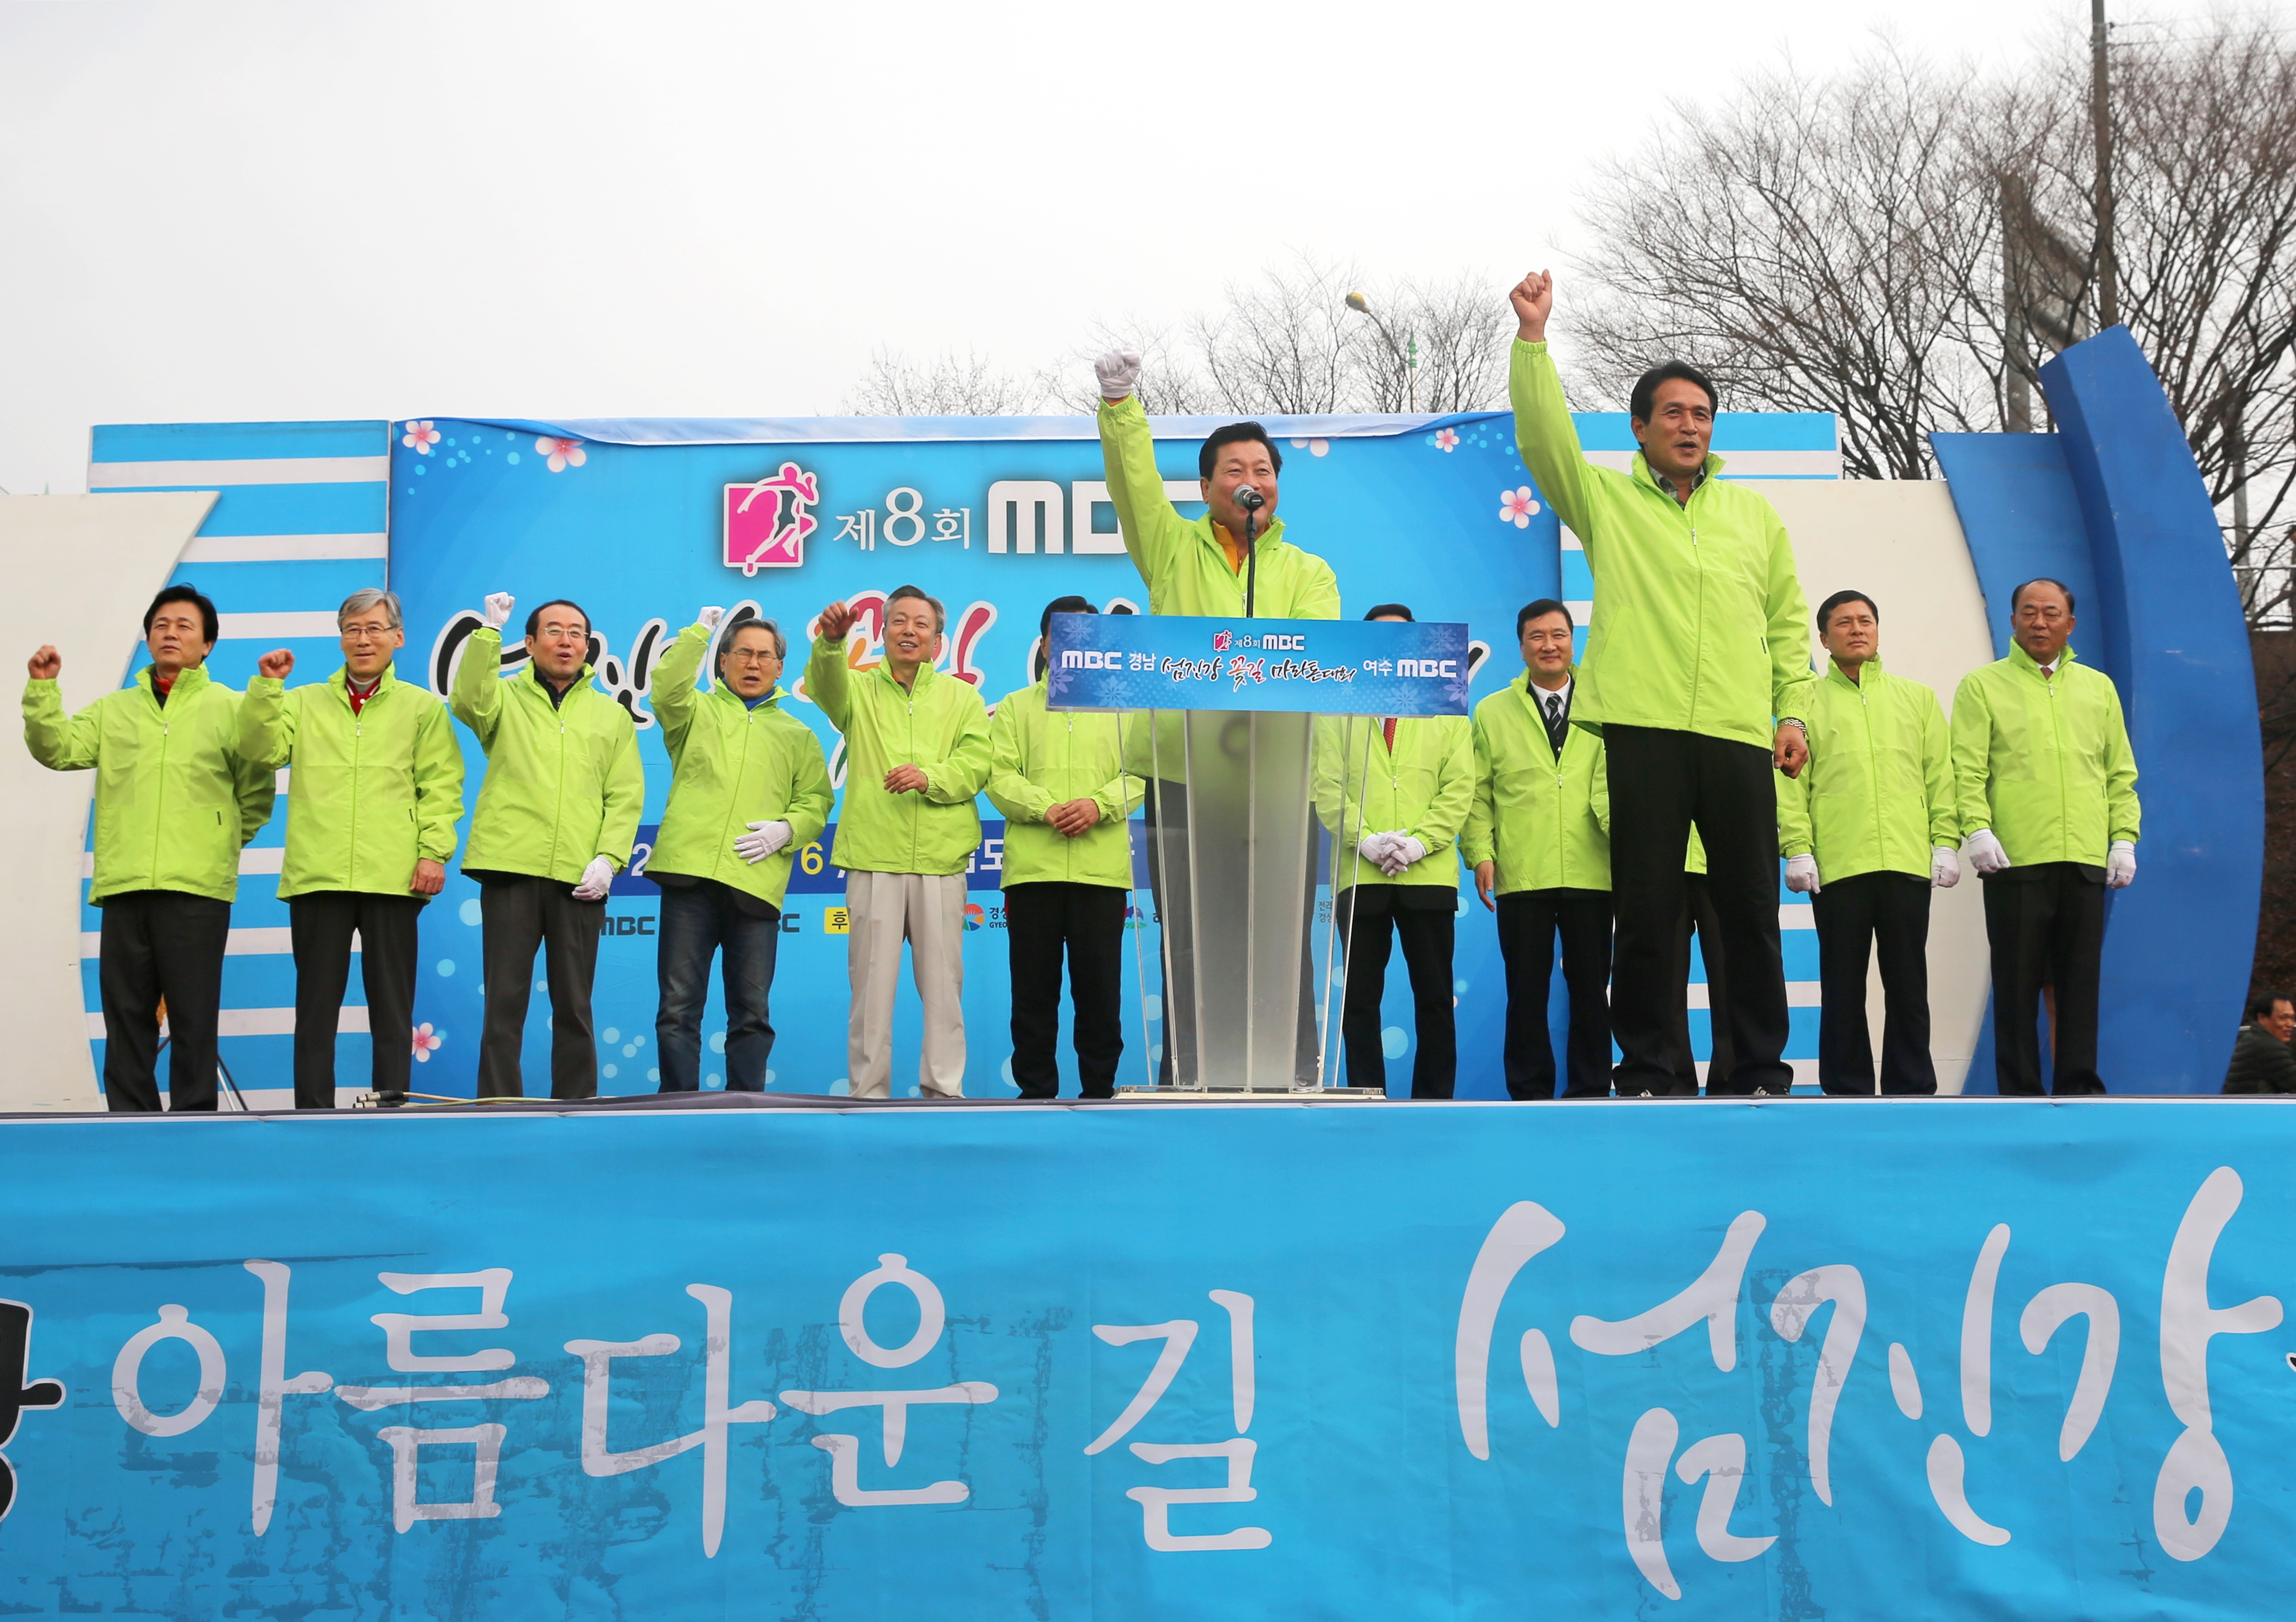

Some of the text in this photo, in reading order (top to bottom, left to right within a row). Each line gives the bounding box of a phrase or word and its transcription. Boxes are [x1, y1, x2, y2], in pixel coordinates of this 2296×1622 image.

[833, 487, 970, 551] 제8회
[1062, 650, 1156, 671] MBC 경남
[1234, 635, 1305, 650] 제8회 MBC
[1160, 656, 1224, 682] 섬진강
[1226, 655, 1267, 693] 꽃길
[1363, 659, 1457, 677] 여수 MBC
[1454, 1166, 2284, 1601] 섬진강
[111, 1252, 999, 1559] 아름다운
[1083, 1289, 1273, 1552] 길
